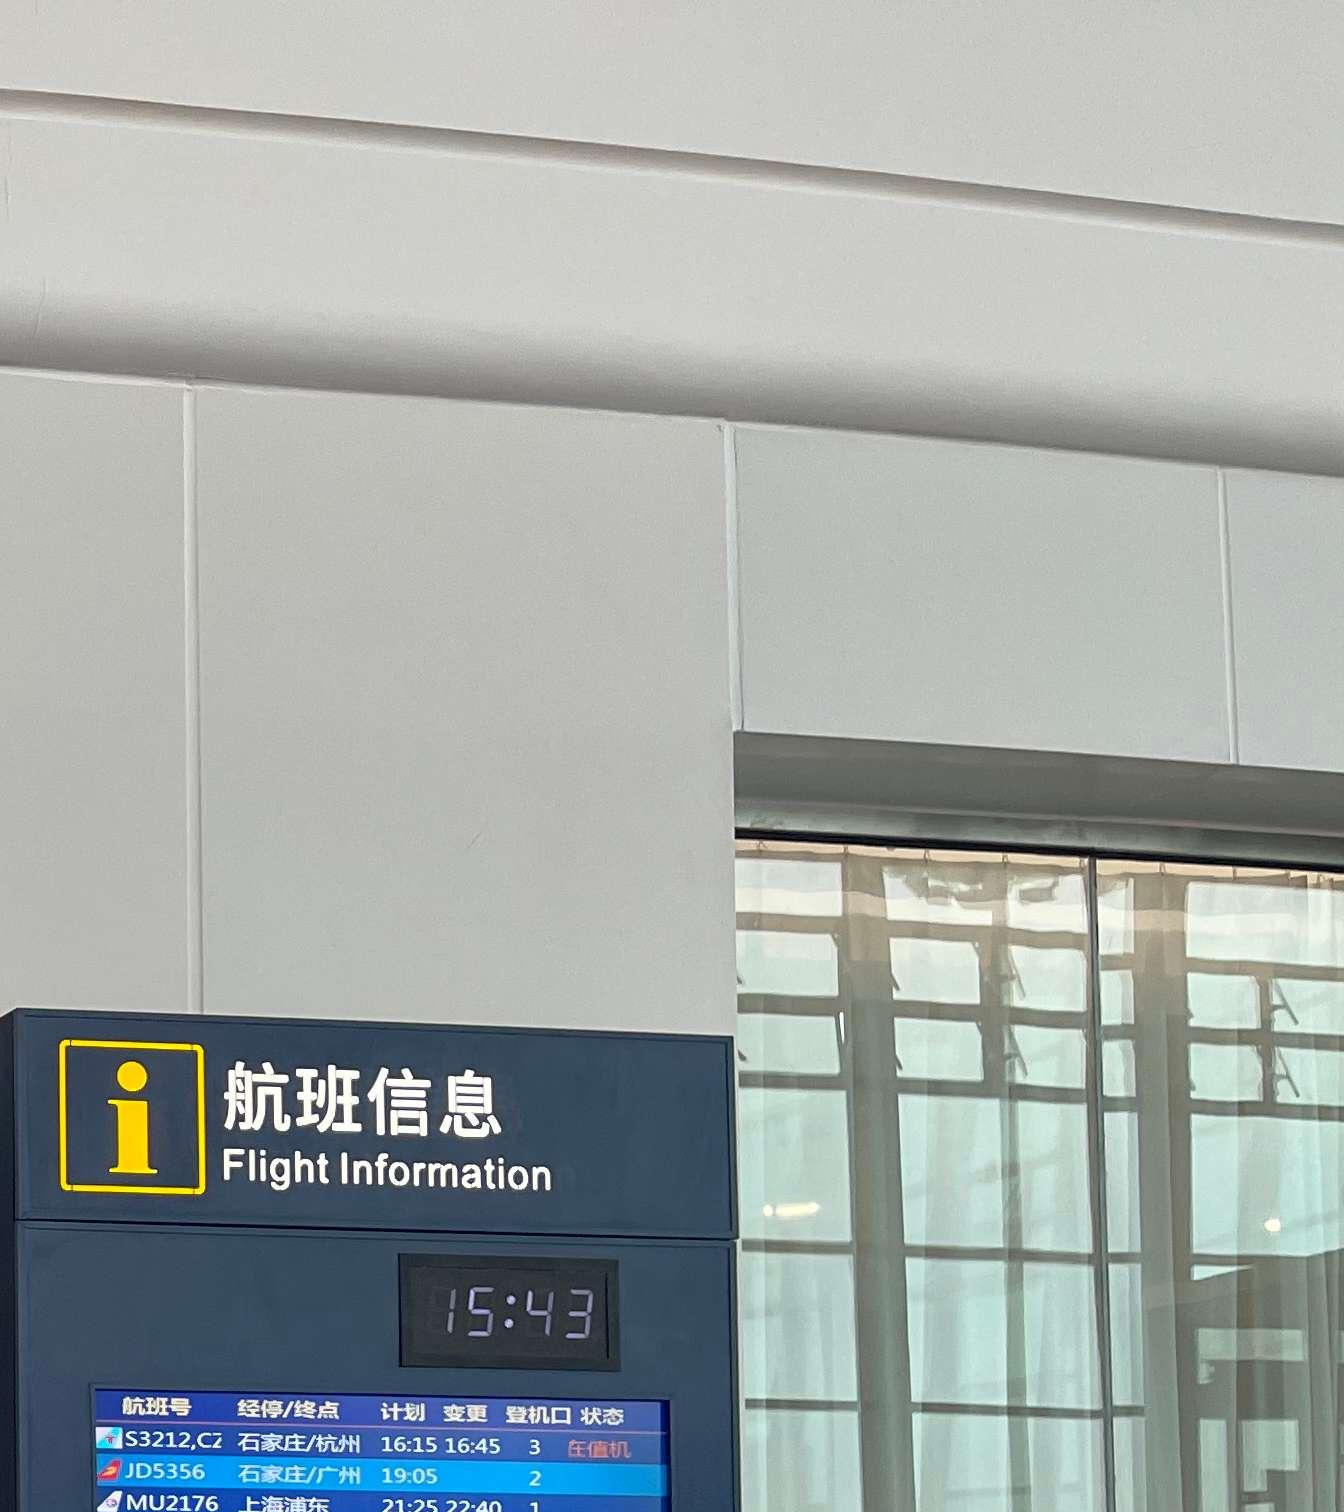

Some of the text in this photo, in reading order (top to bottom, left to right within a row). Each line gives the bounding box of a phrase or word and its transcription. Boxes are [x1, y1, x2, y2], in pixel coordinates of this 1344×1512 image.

[223, 1060, 503, 1139] 航班信息
[223, 1149, 553, 1192] Flight Information
[446, 1286, 595, 1340] 15:43
[122, 1396, 625, 1425] 航班号 经停/终点 计划 变更 登机口 状态
[238, 1432, 360, 1454] 石家庄/杭州
[381, 1436, 438, 1453] 16:15
[445, 1438, 501, 1455] 16:45
[529, 1439, 541, 1455] 3
[125, 1462, 542, 1487] JD5356 石家庄/广州 19:05 2
[126, 1495, 219, 1512] MU2176
